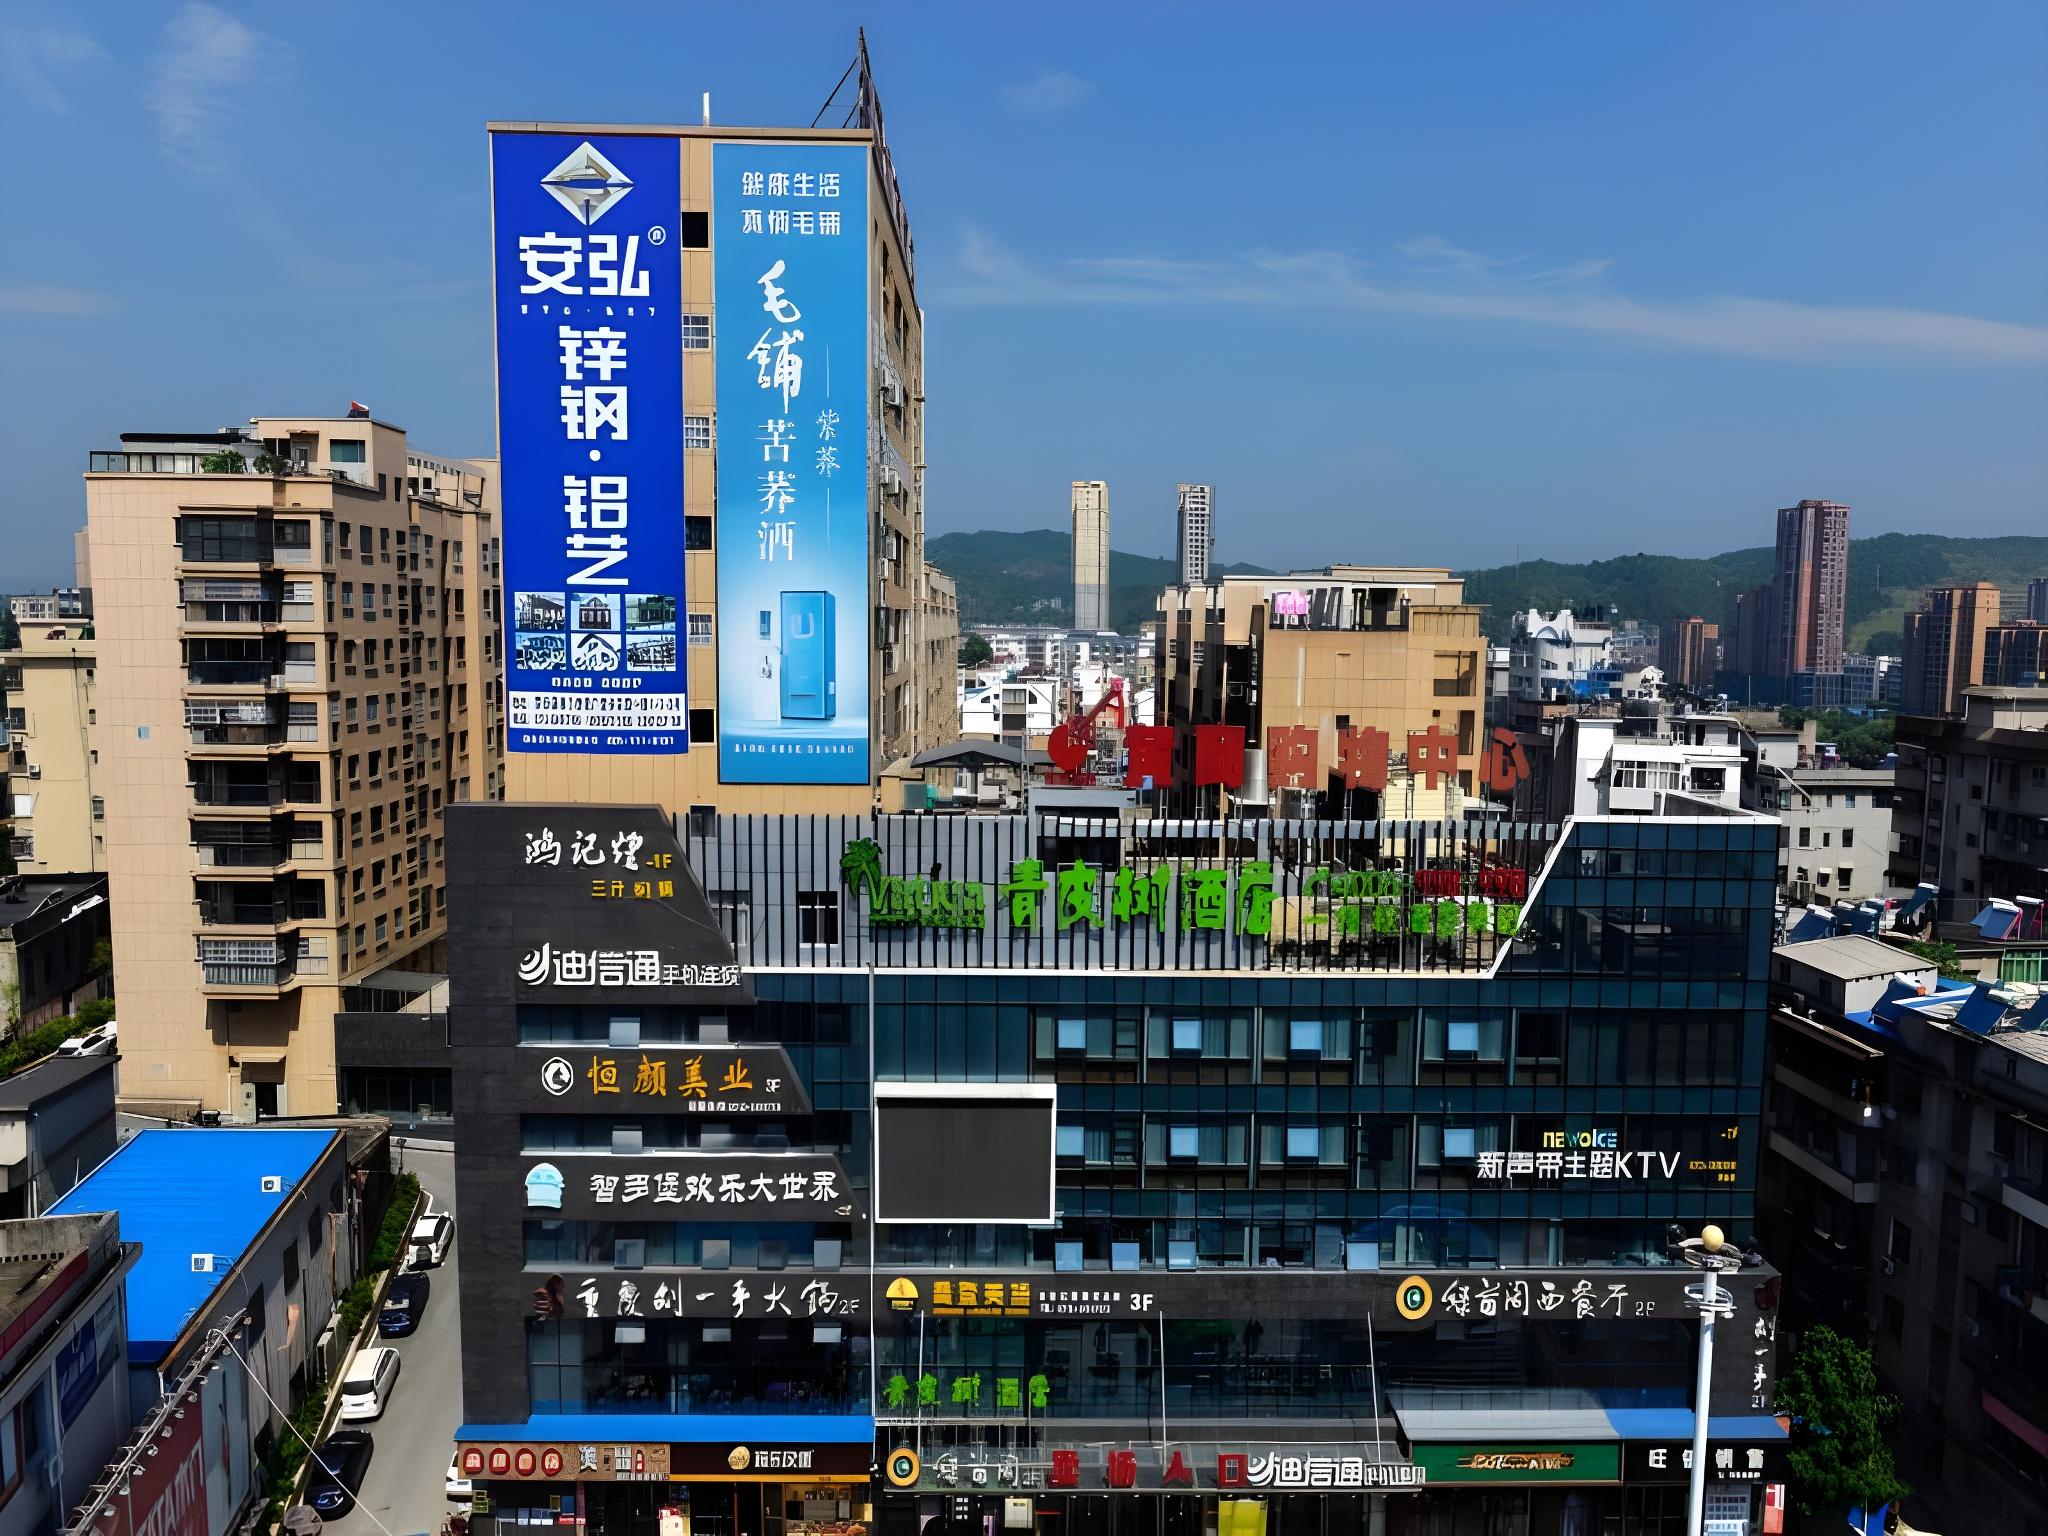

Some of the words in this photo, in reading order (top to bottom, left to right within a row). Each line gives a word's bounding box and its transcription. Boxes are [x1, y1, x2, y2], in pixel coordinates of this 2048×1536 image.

[519, 231, 650, 297] 安弘
[589, 1171, 840, 1203] 智多堡欢乐大世界
[1130, 1292, 1154, 1312] 3F
